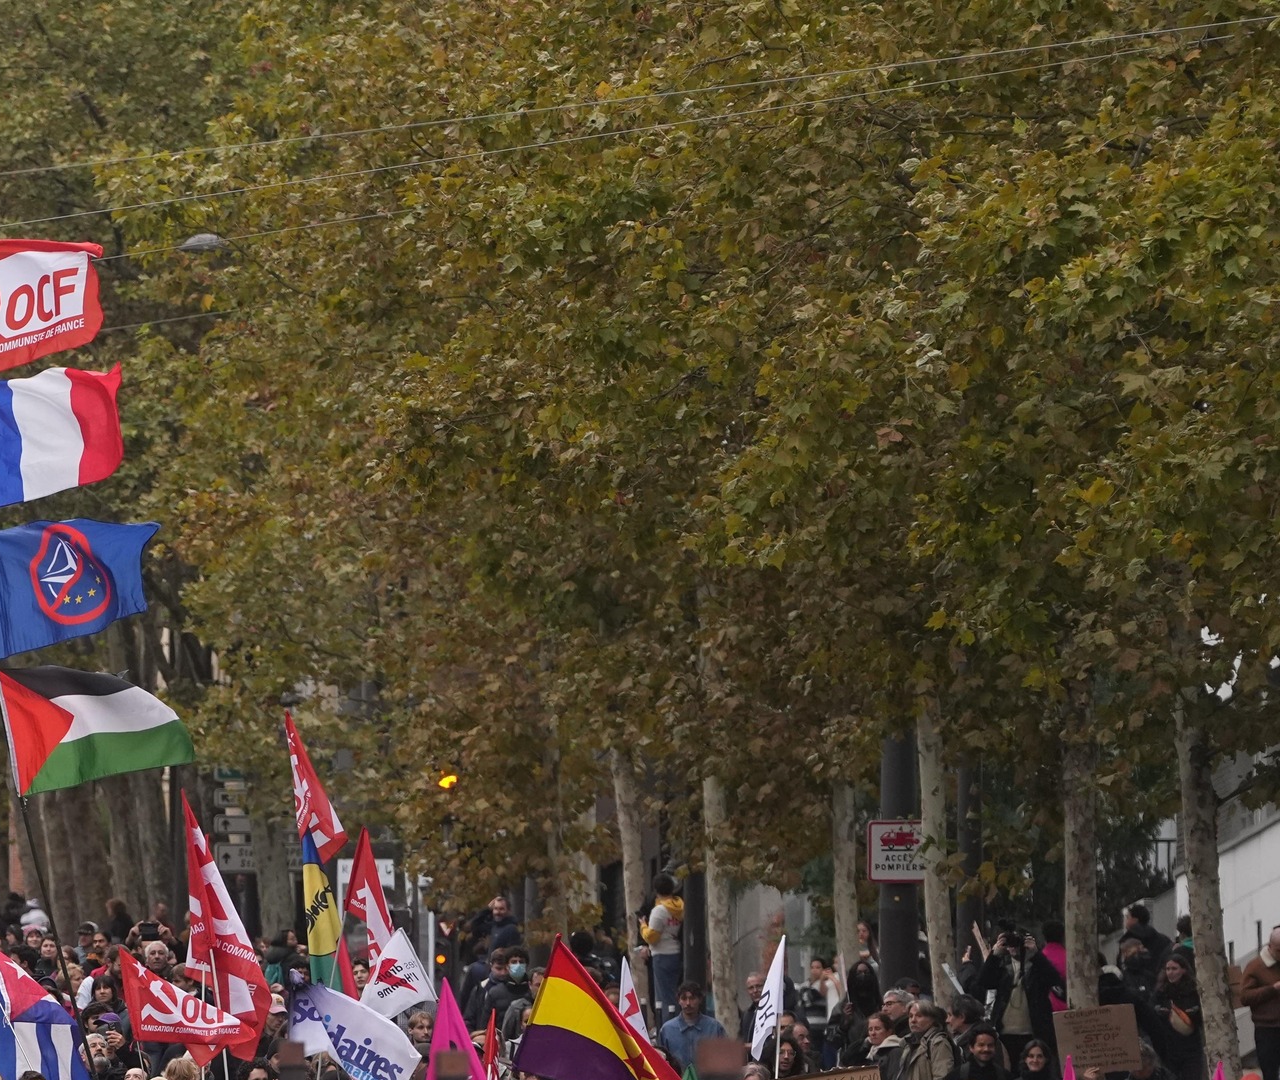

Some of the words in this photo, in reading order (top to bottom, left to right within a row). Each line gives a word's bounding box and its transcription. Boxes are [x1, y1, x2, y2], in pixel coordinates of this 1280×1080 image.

[5, 267, 79, 331] OCF
[45, 328, 54, 339] DE
[53, 318, 85, 336] FRANCE
[174, 1026, 209, 1036] COMMUNISTE
[209, 1028, 218, 1036] DE
[218, 1027, 240, 1035] FRANCE
[1083, 1032, 1119, 1043] STOP
